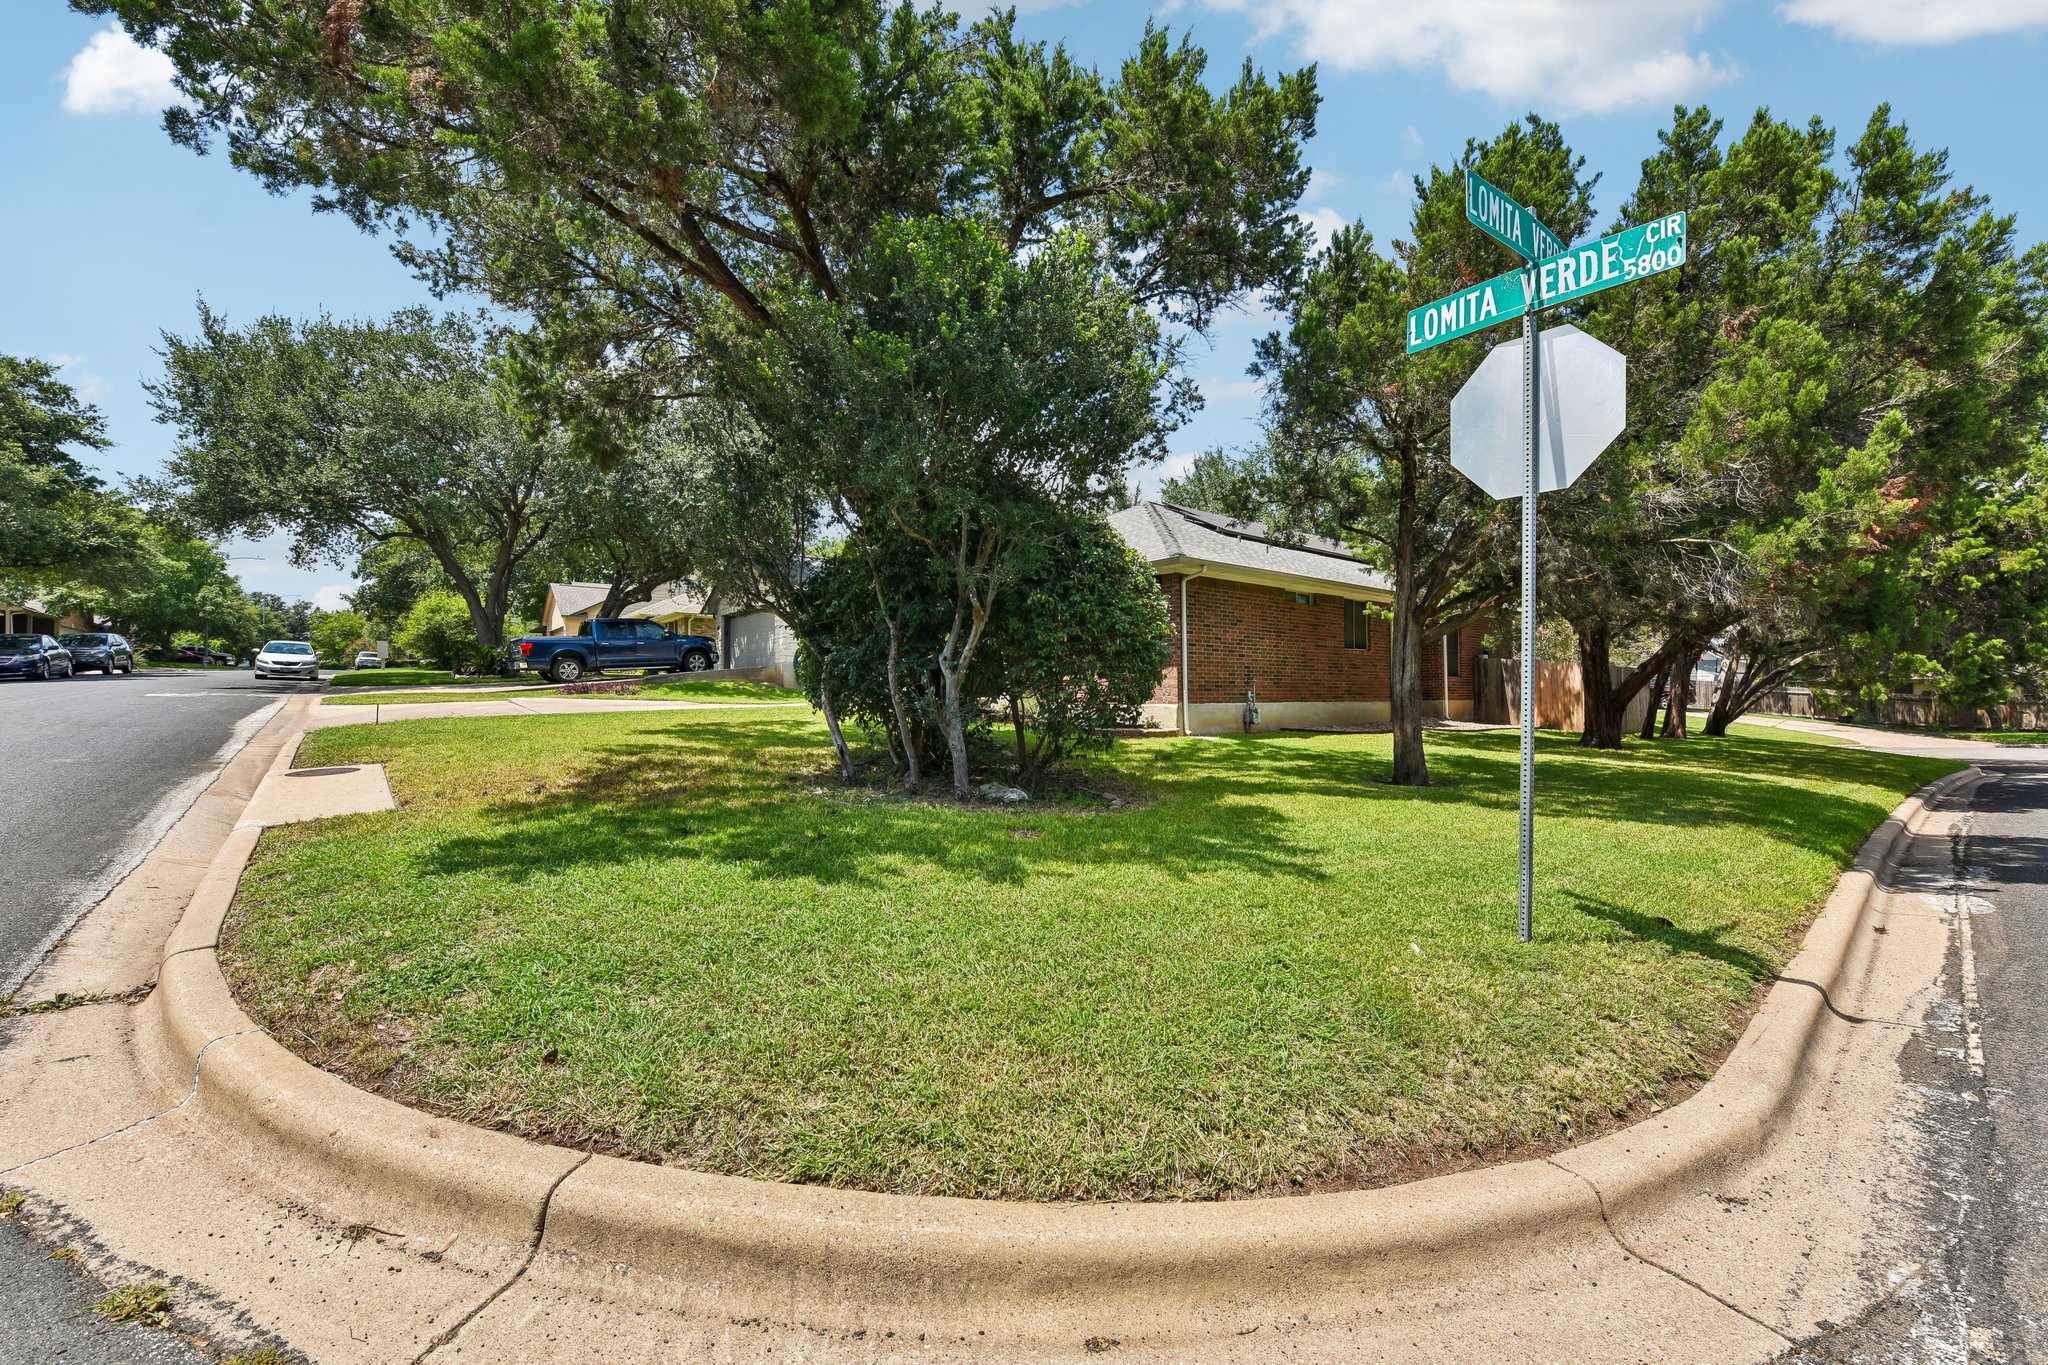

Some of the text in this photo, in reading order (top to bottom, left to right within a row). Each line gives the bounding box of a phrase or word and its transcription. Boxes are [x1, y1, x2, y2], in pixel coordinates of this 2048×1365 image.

[1469, 177, 1522, 246] LOMITA
[1410, 211, 1682, 347] LOMITA VERDE CIR
[1623, 245, 1682, 280] 5800
